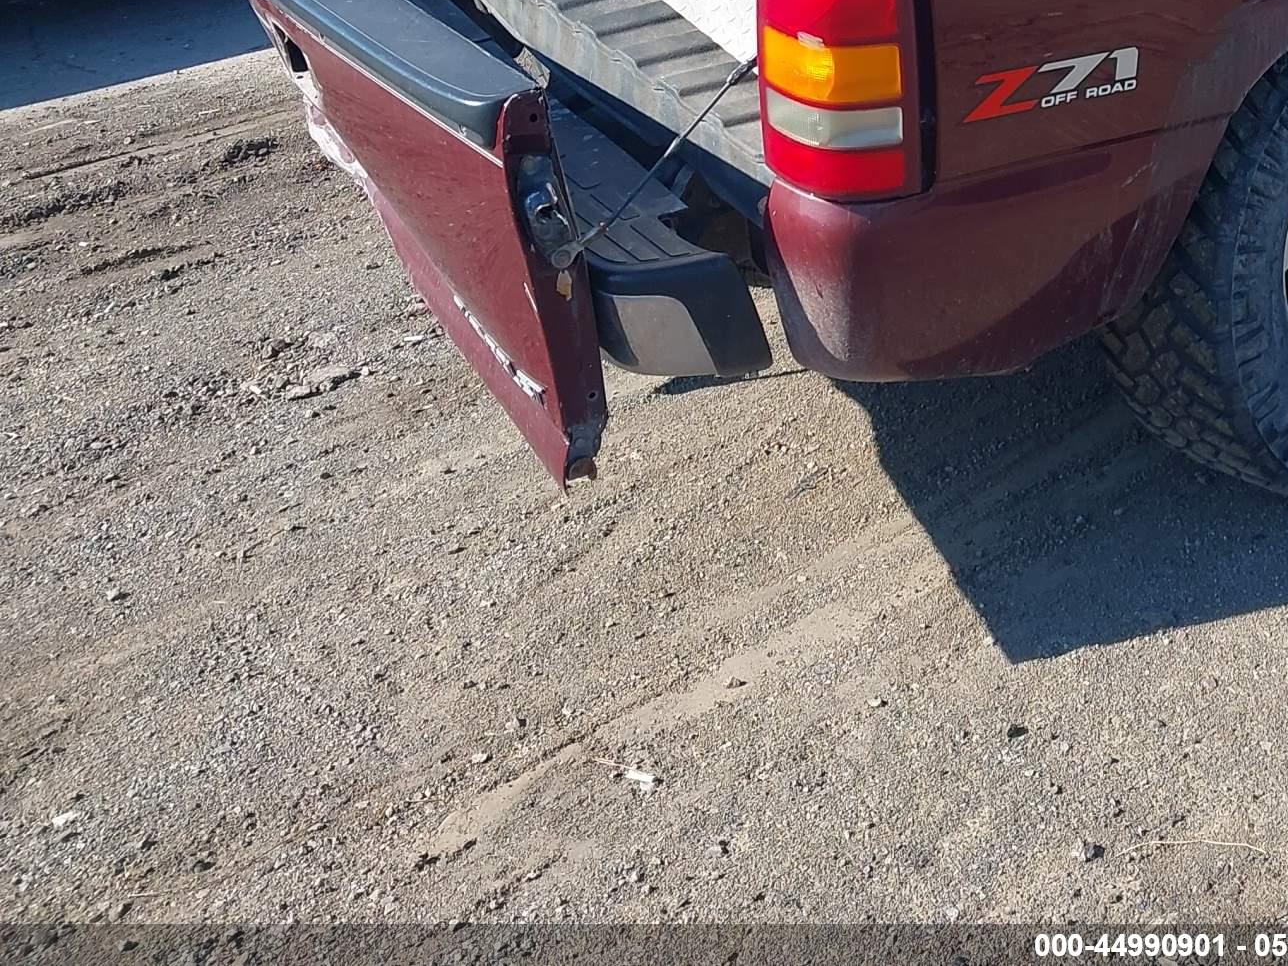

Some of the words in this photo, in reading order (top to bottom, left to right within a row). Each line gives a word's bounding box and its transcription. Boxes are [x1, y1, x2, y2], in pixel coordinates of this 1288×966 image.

[963, 46, 1139, 123] Z71
[1041, 91, 1078, 108] OFF
[1085, 79, 1138, 99] ROAD
